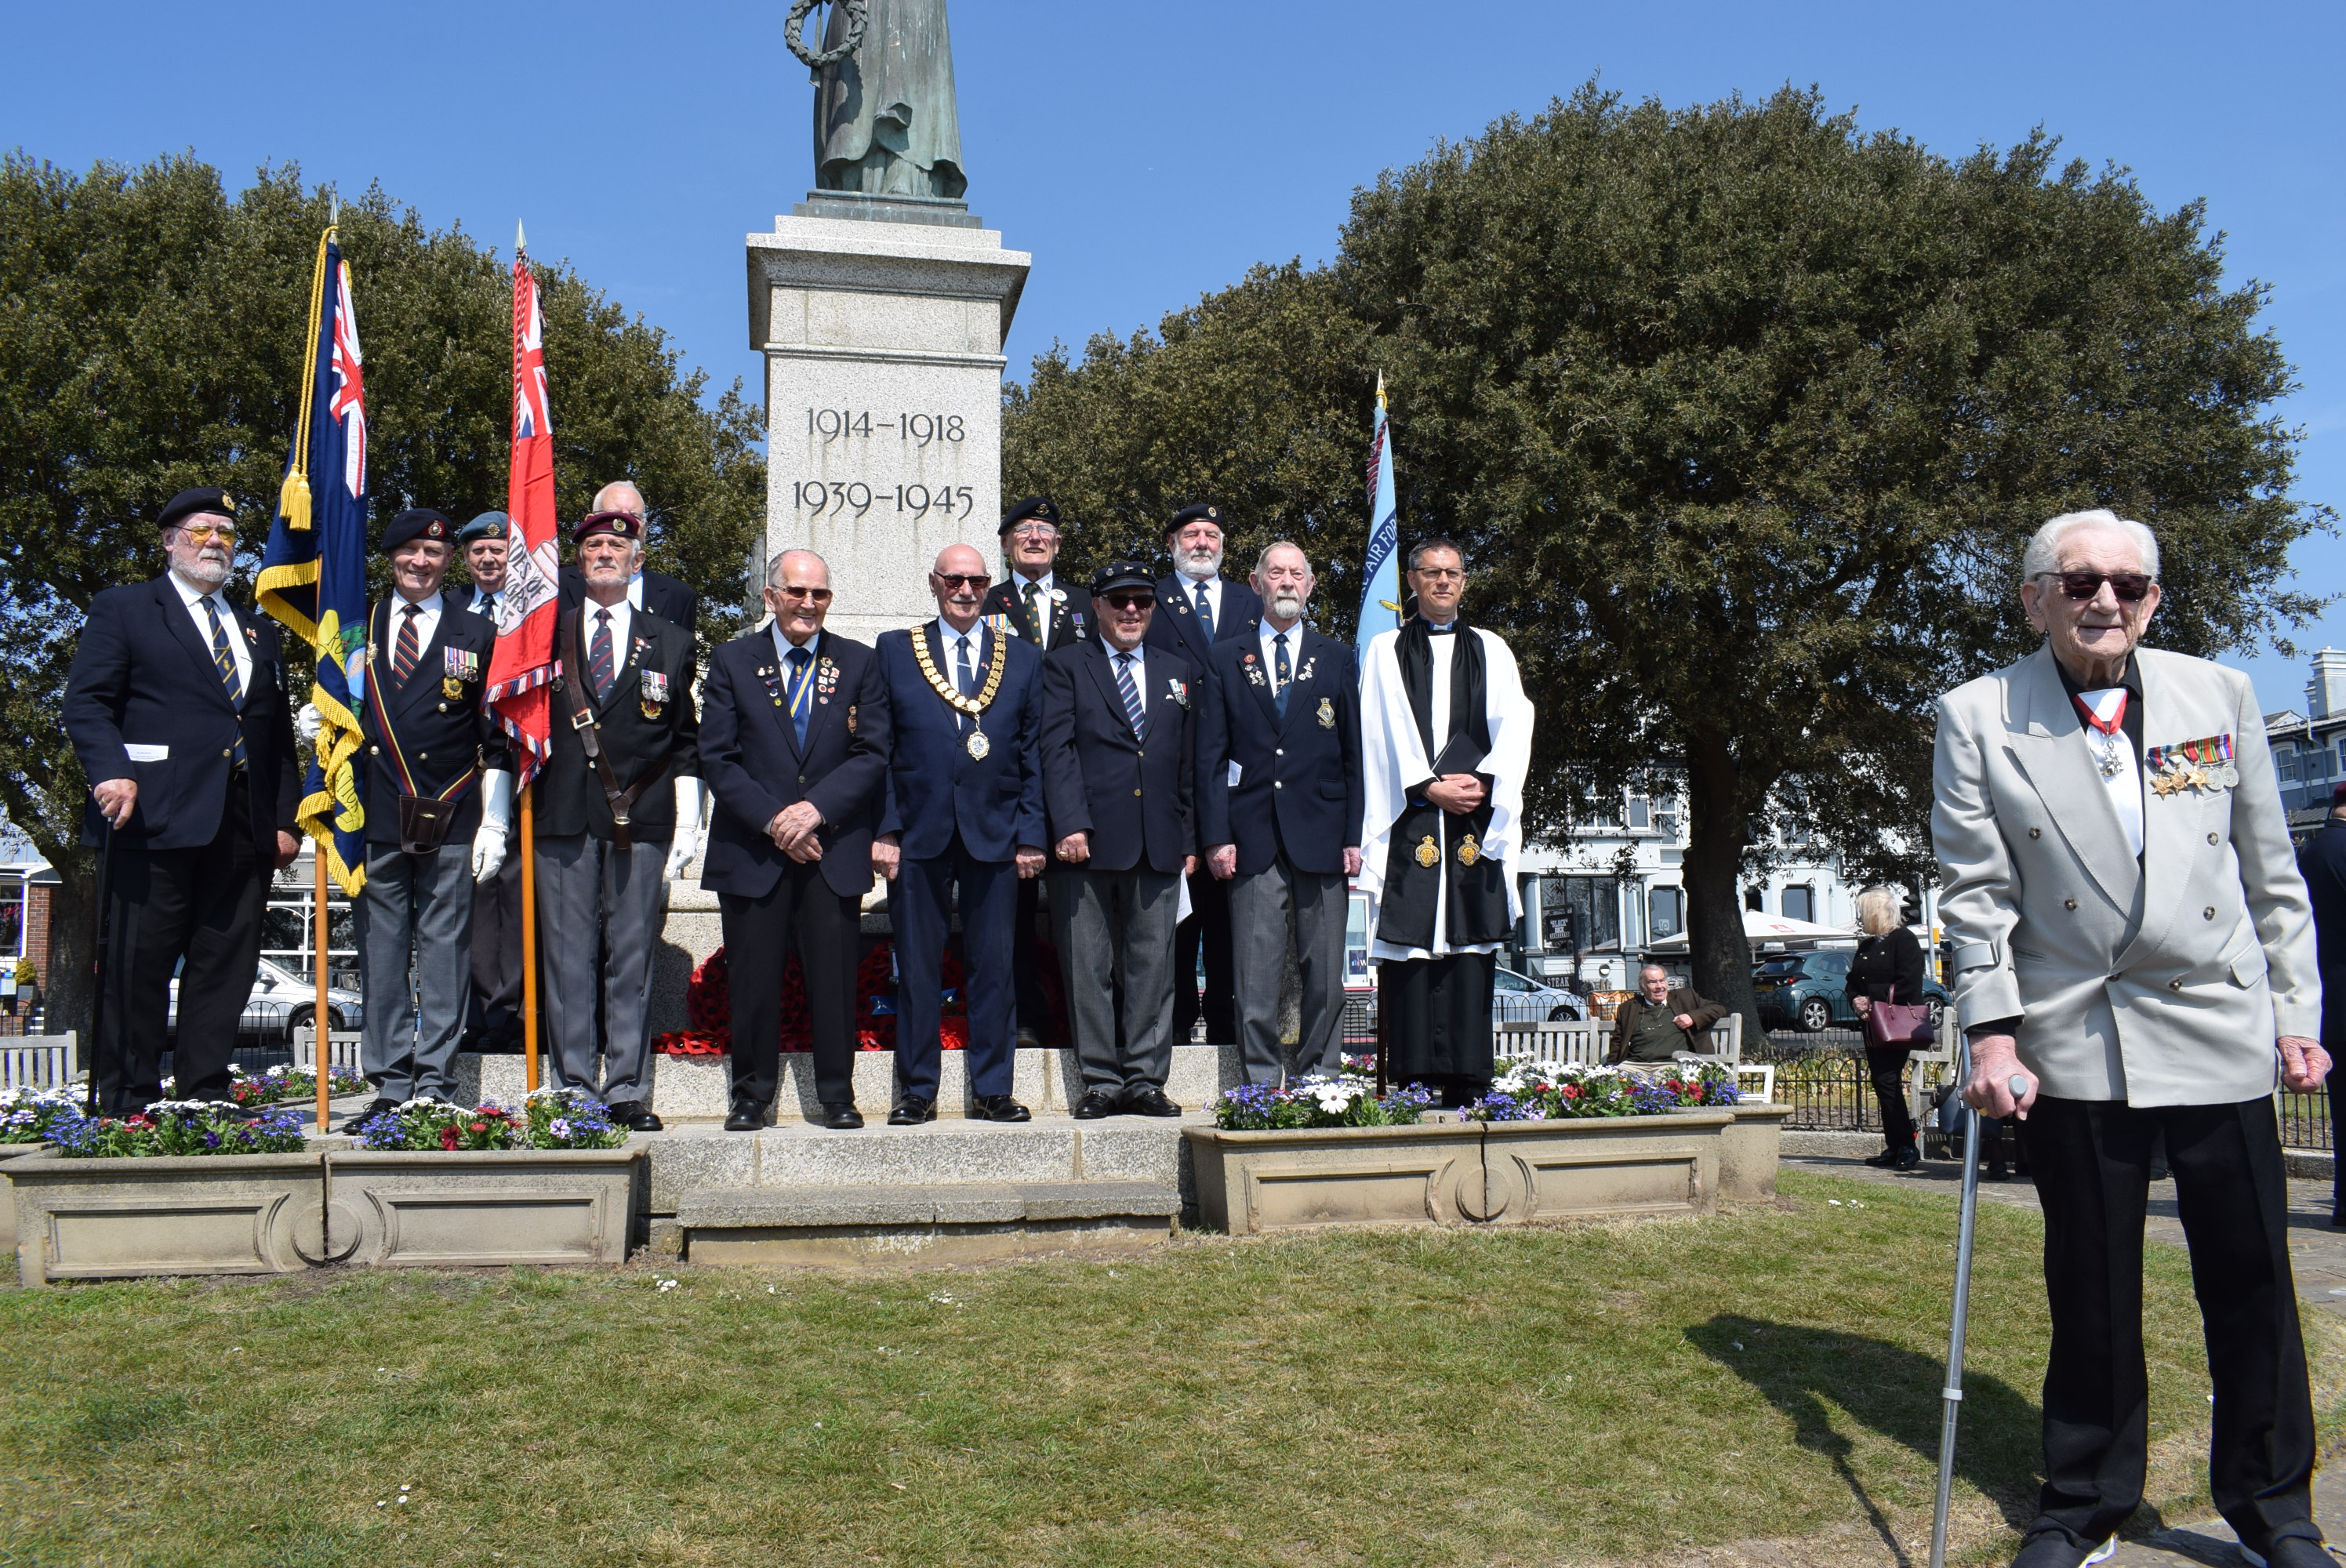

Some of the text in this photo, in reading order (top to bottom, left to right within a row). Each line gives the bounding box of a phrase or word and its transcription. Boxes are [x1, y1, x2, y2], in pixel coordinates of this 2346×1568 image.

[1366, 543, 1385, 572] AIR
[526, 576, 550, 598] OF
[1547, 977, 1569, 987] STEAK
